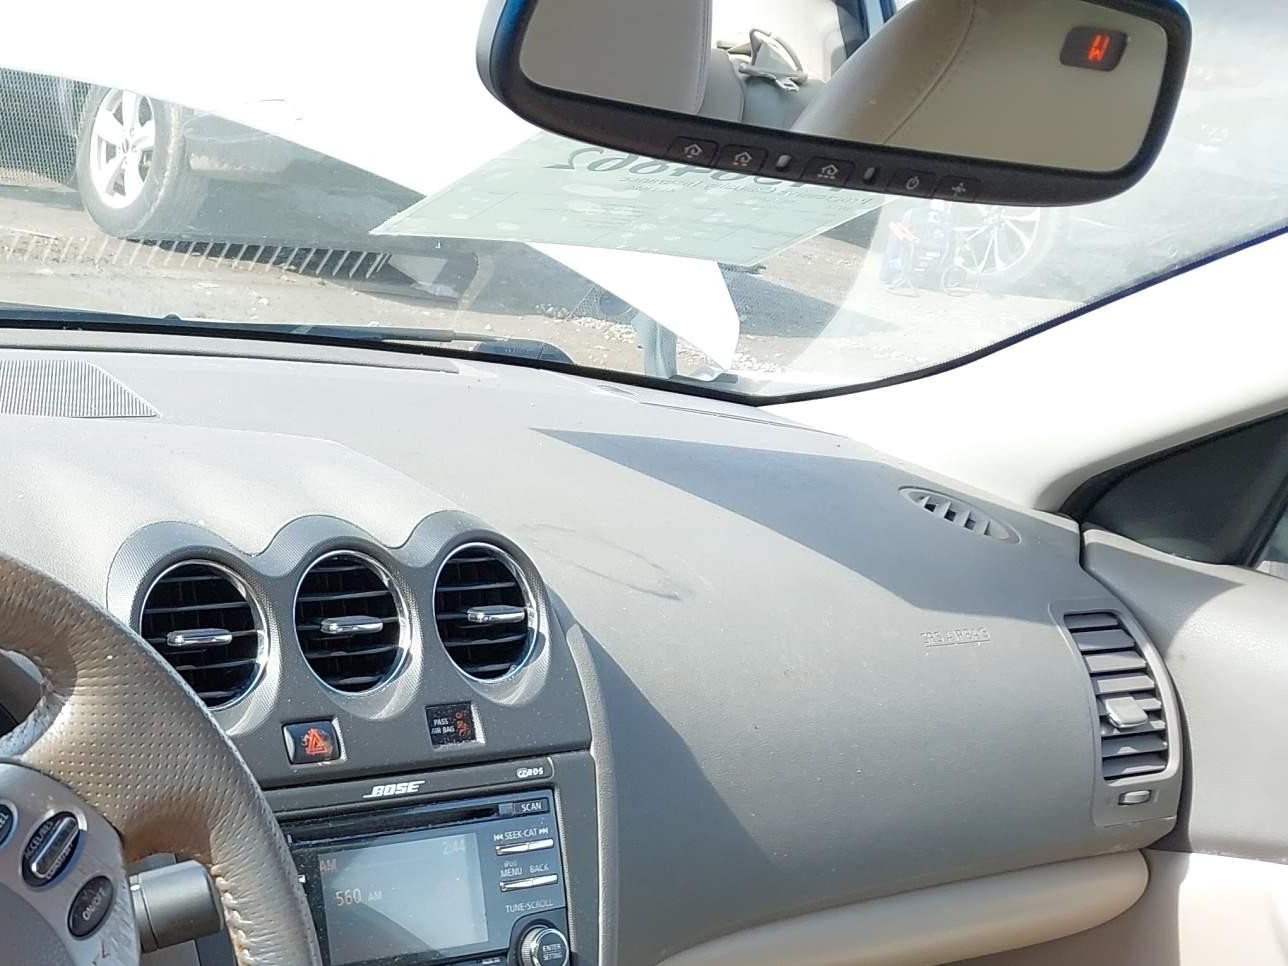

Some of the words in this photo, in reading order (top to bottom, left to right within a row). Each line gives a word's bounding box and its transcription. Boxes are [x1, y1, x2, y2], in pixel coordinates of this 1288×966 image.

[433, 718, 449, 726] PASS
[363, 780, 425, 798] BOSE
[521, 802, 542, 812] SCAN
[319, 858, 337, 872] AM
[500, 867, 523, 877] MENU
[335, 888, 362, 906] 560
